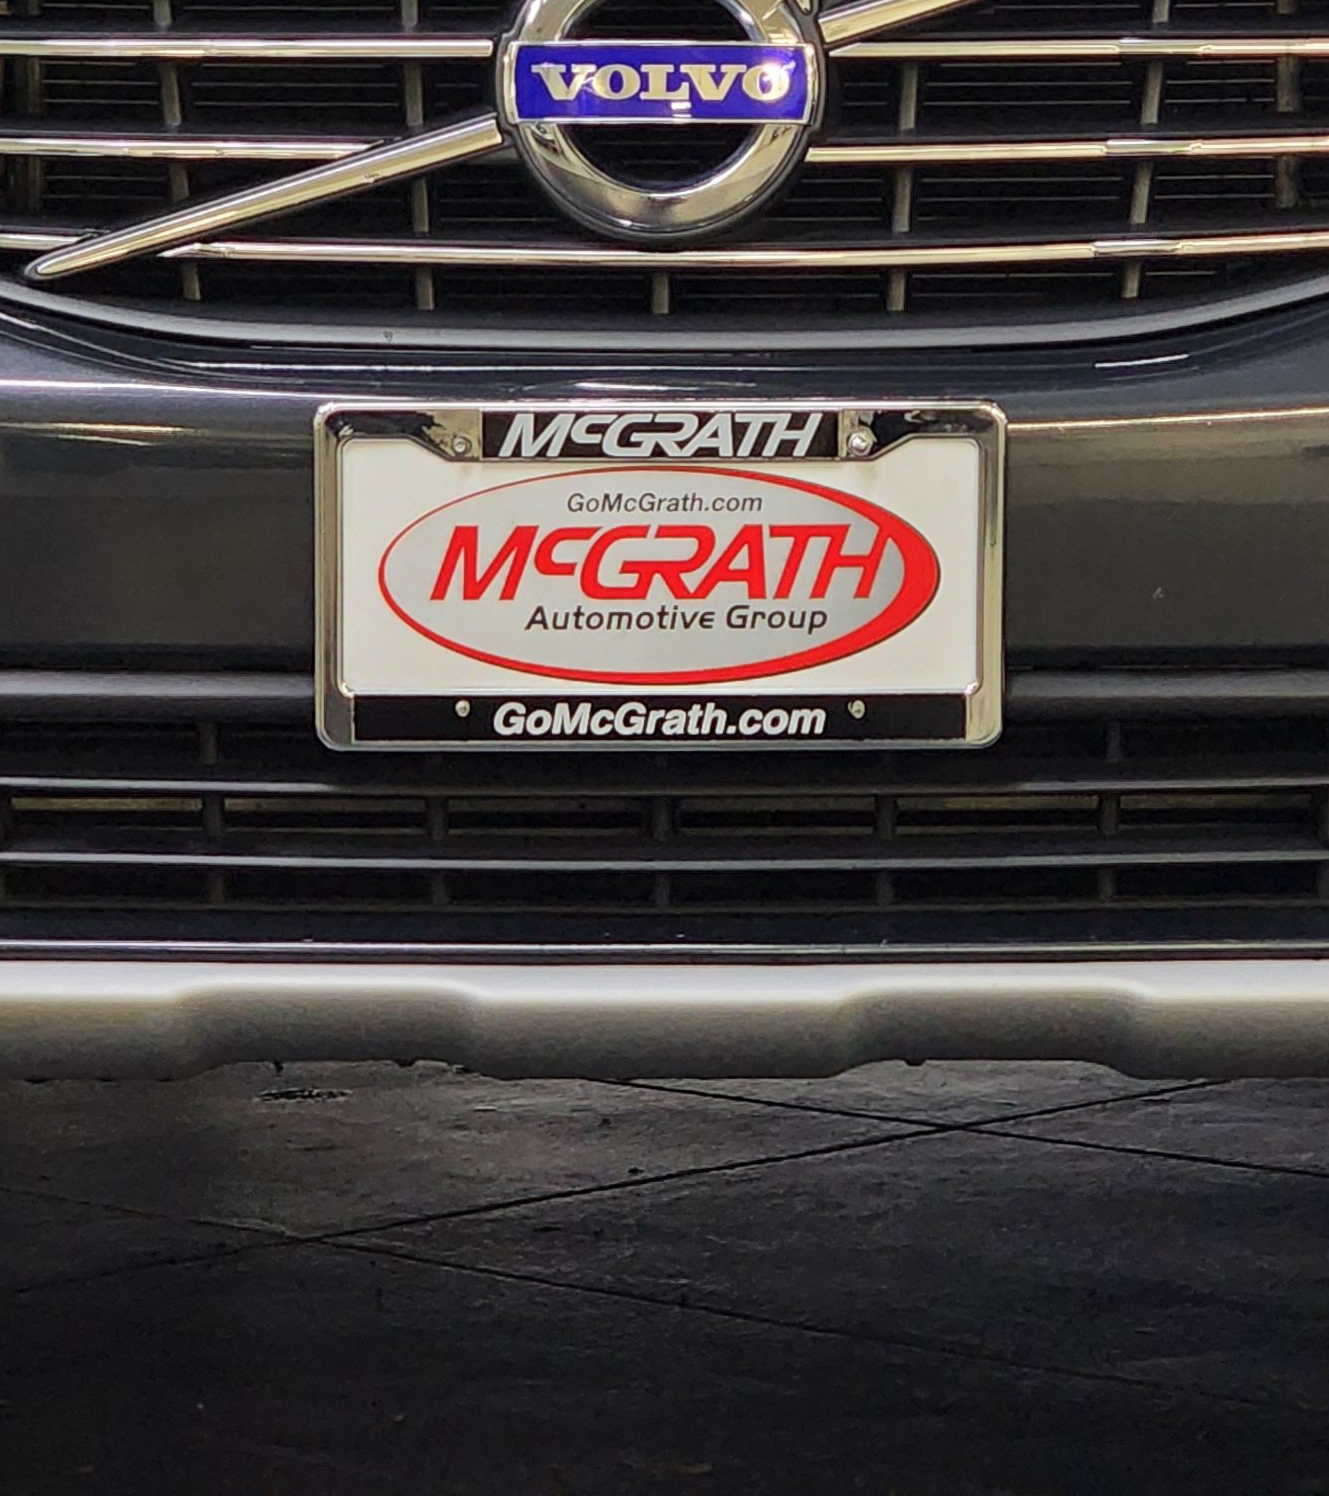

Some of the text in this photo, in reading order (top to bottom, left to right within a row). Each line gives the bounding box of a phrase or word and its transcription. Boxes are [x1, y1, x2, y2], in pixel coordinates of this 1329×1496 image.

[530, 63, 792, 101] VOLVO
[566, 492, 763, 513] GoMcGrath.com
[524, 604, 828, 635] Automotive Group
[493, 701, 826, 737] GoMcGrath.com
